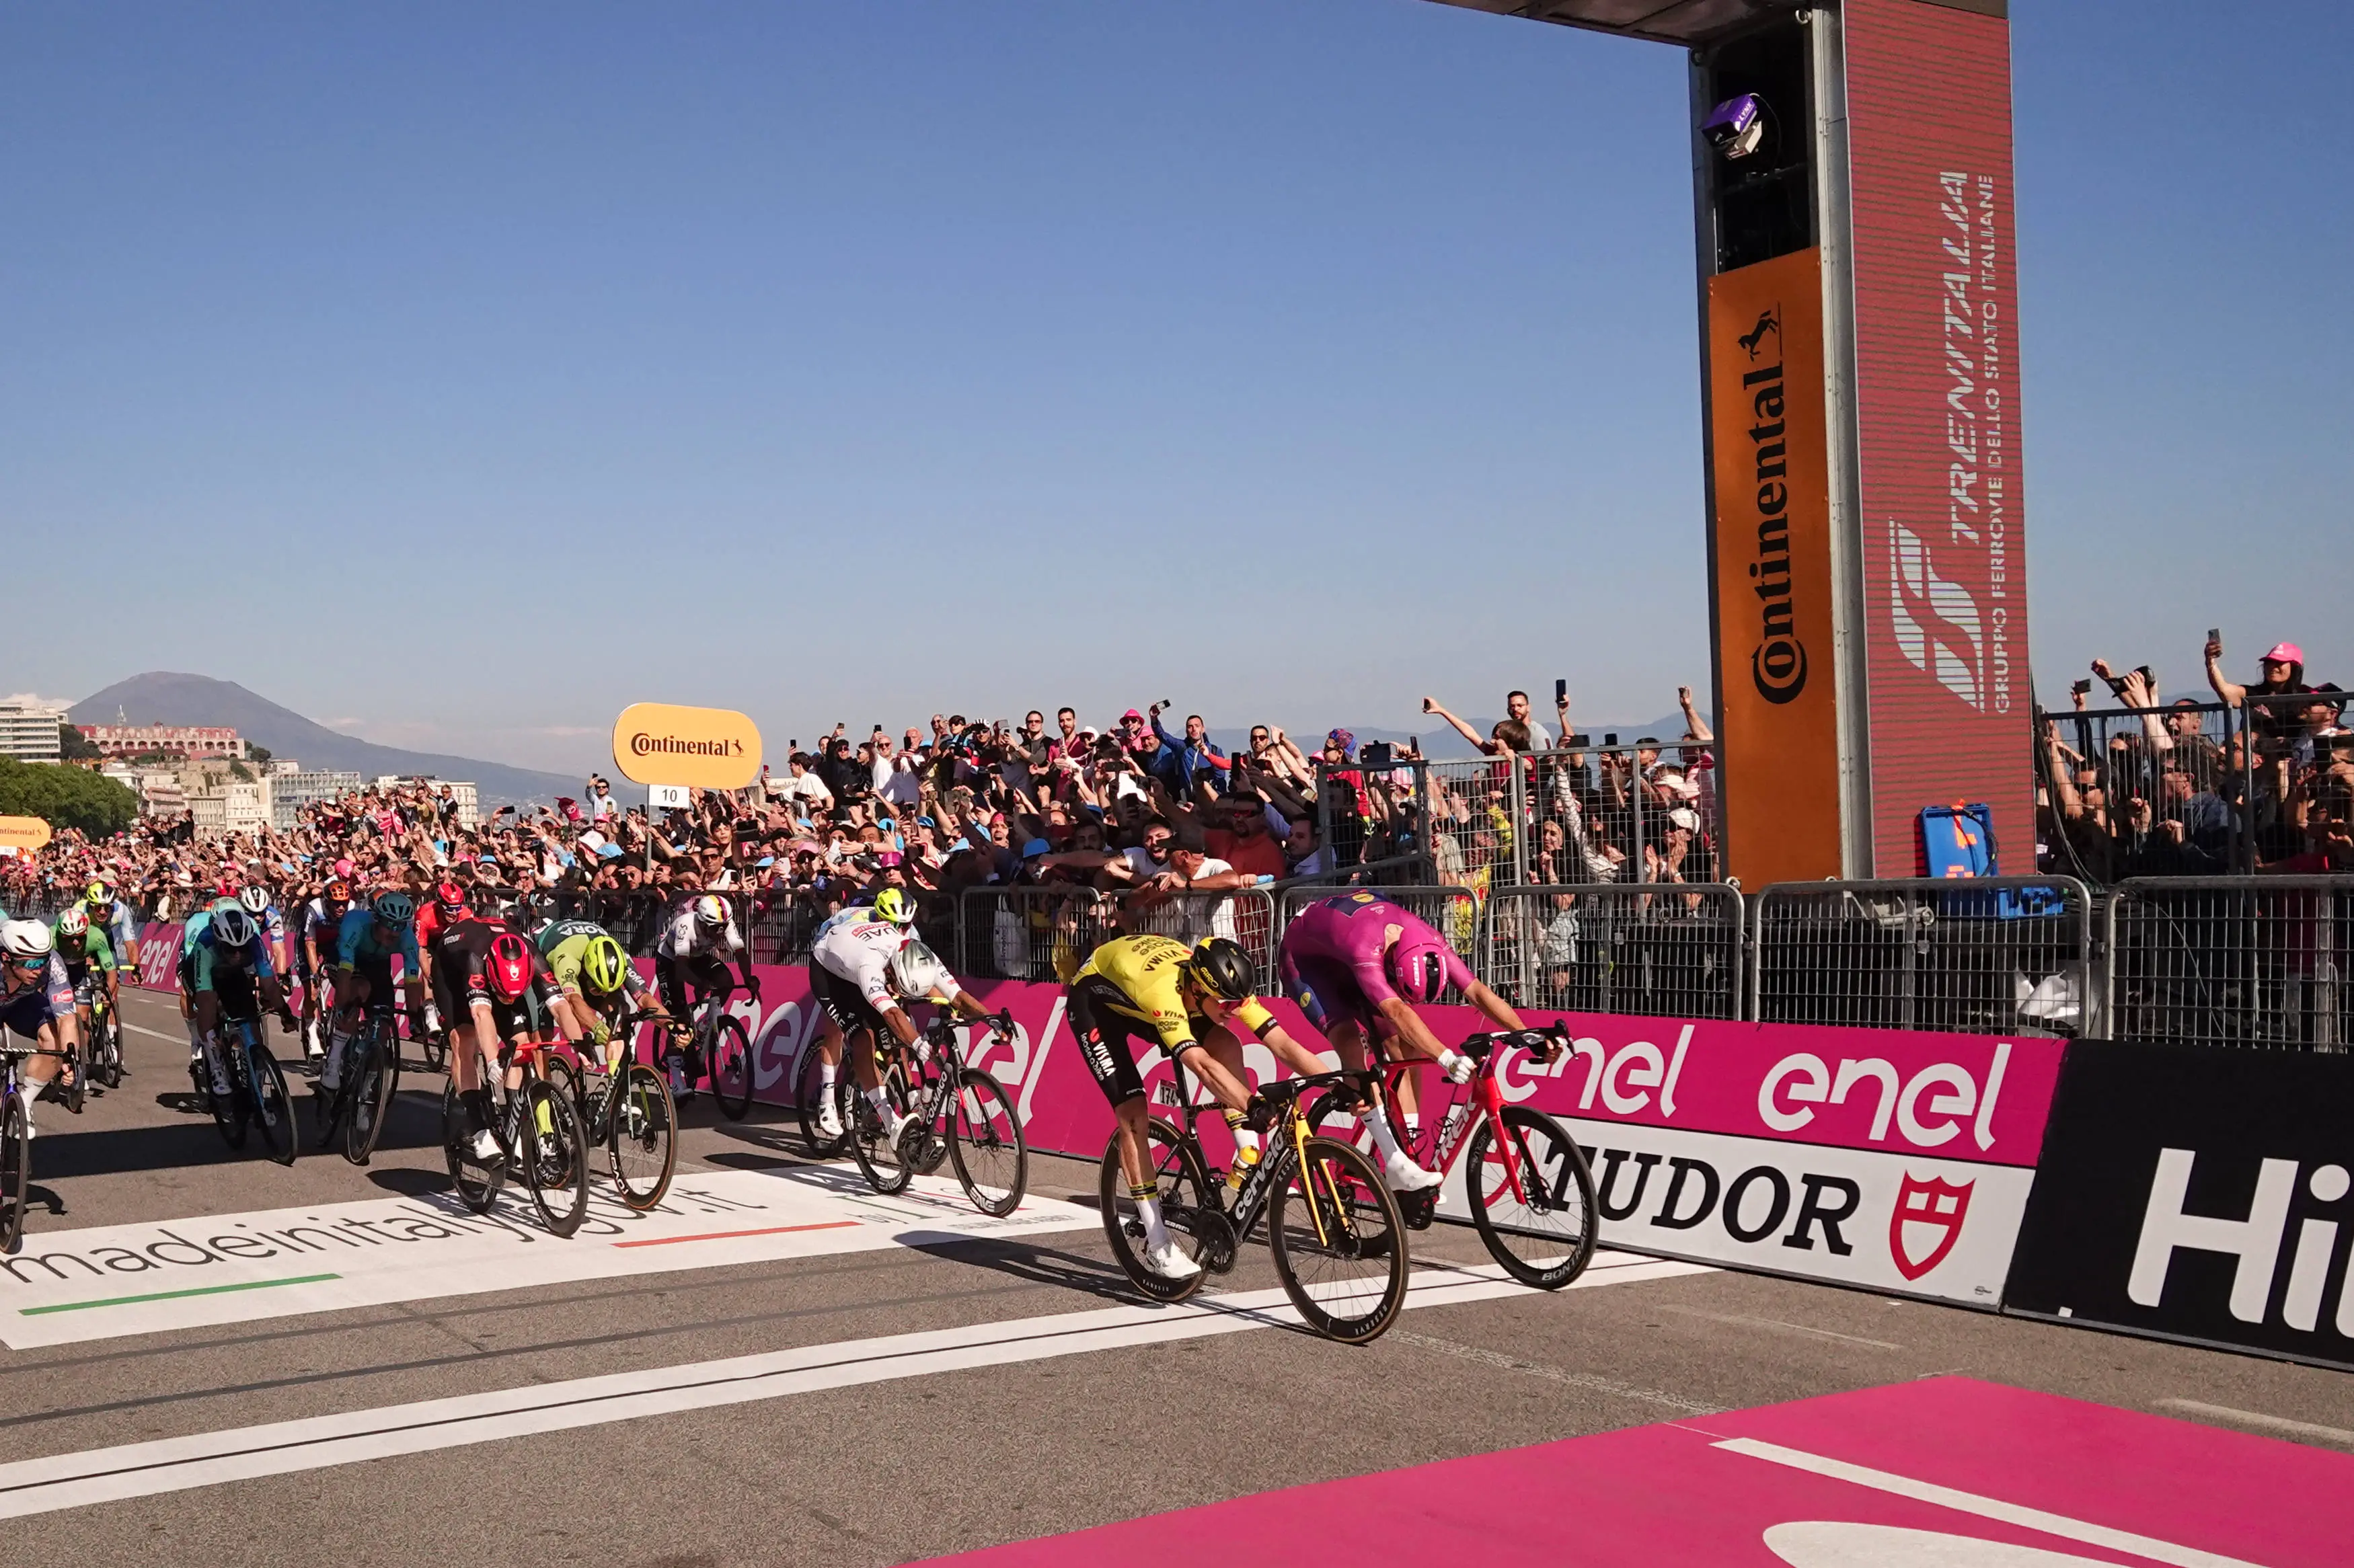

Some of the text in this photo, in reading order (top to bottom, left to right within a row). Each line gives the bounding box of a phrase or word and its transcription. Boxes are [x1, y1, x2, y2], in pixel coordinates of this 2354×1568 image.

[1940, 172, 1980, 545] TRENITALIA
[1979, 175, 2010, 714] GRUPPO FERROVIE DELLO STATO ITALIANE
[1744, 360, 1807, 705] Continental
[631, 732, 730, 756] Continental
[661, 789, 678, 803] 10
[676, 923, 688, 947] INEOS
[858, 927, 899, 942] UAE
[139, 929, 182, 984] enel
[1144, 949, 1184, 972] VISMA
[1412, 955, 1420, 987] TREK
[658, 972, 673, 1007] INEOS
[827, 1003, 845, 1029] UAE
[1080, 1032, 1091, 1058] lease
[1092, 1062, 1105, 1082] bike
[1093, 1042, 1117, 1076] VISMA
[1494, 1024, 1695, 1118] enel
[925, 1070, 949, 1126] COLNAGO
[1160, 1085, 1176, 1107] 174
[1758, 1044, 2011, 1152] enel
[1429, 1089, 1478, 1173] TREK
[1545, 1146, 1861, 1257] TUDOR
[1164, 1219, 1190, 1234] SRAM
[1354, 1302, 1388, 1337] RESERVE
